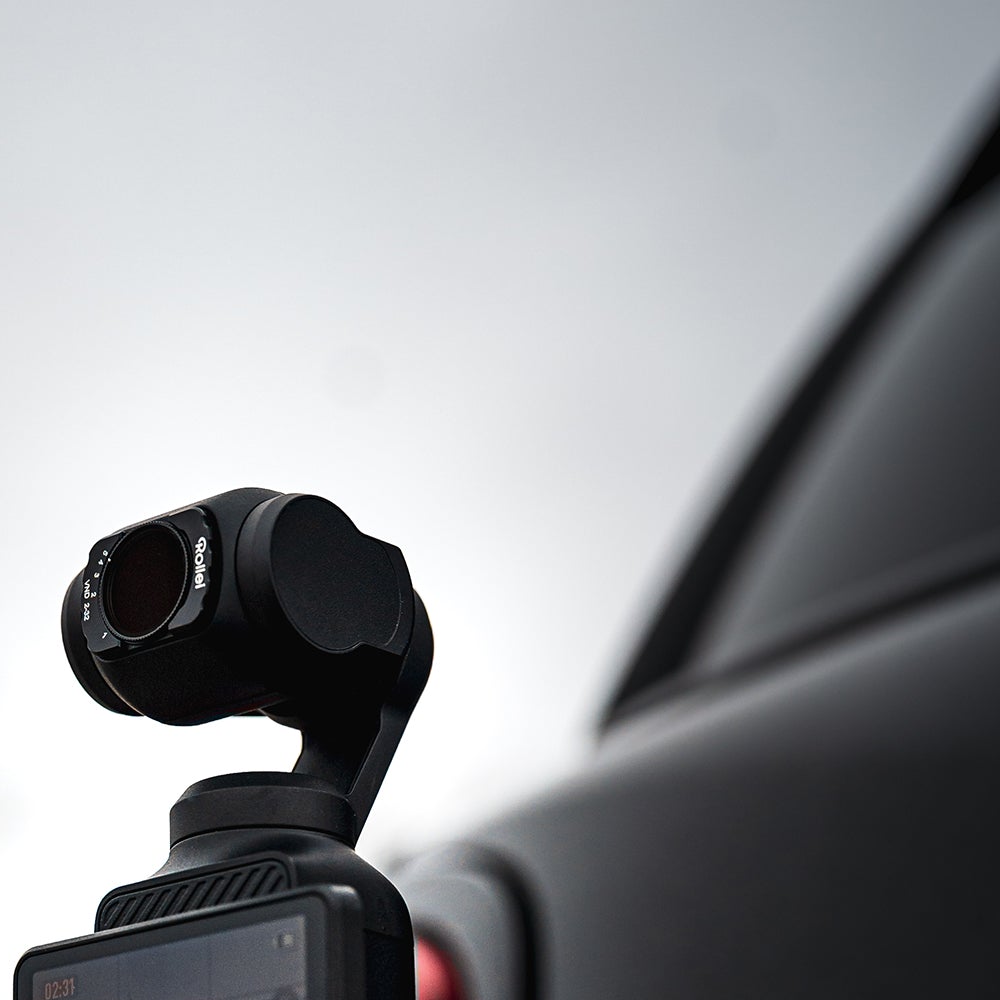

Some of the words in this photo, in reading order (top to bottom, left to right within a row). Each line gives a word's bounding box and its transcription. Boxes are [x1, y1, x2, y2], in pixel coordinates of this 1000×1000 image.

[194, 536, 207, 590] Rollei
[83, 579, 91, 599] VND
[44, 976, 75, 1000] 02:31
